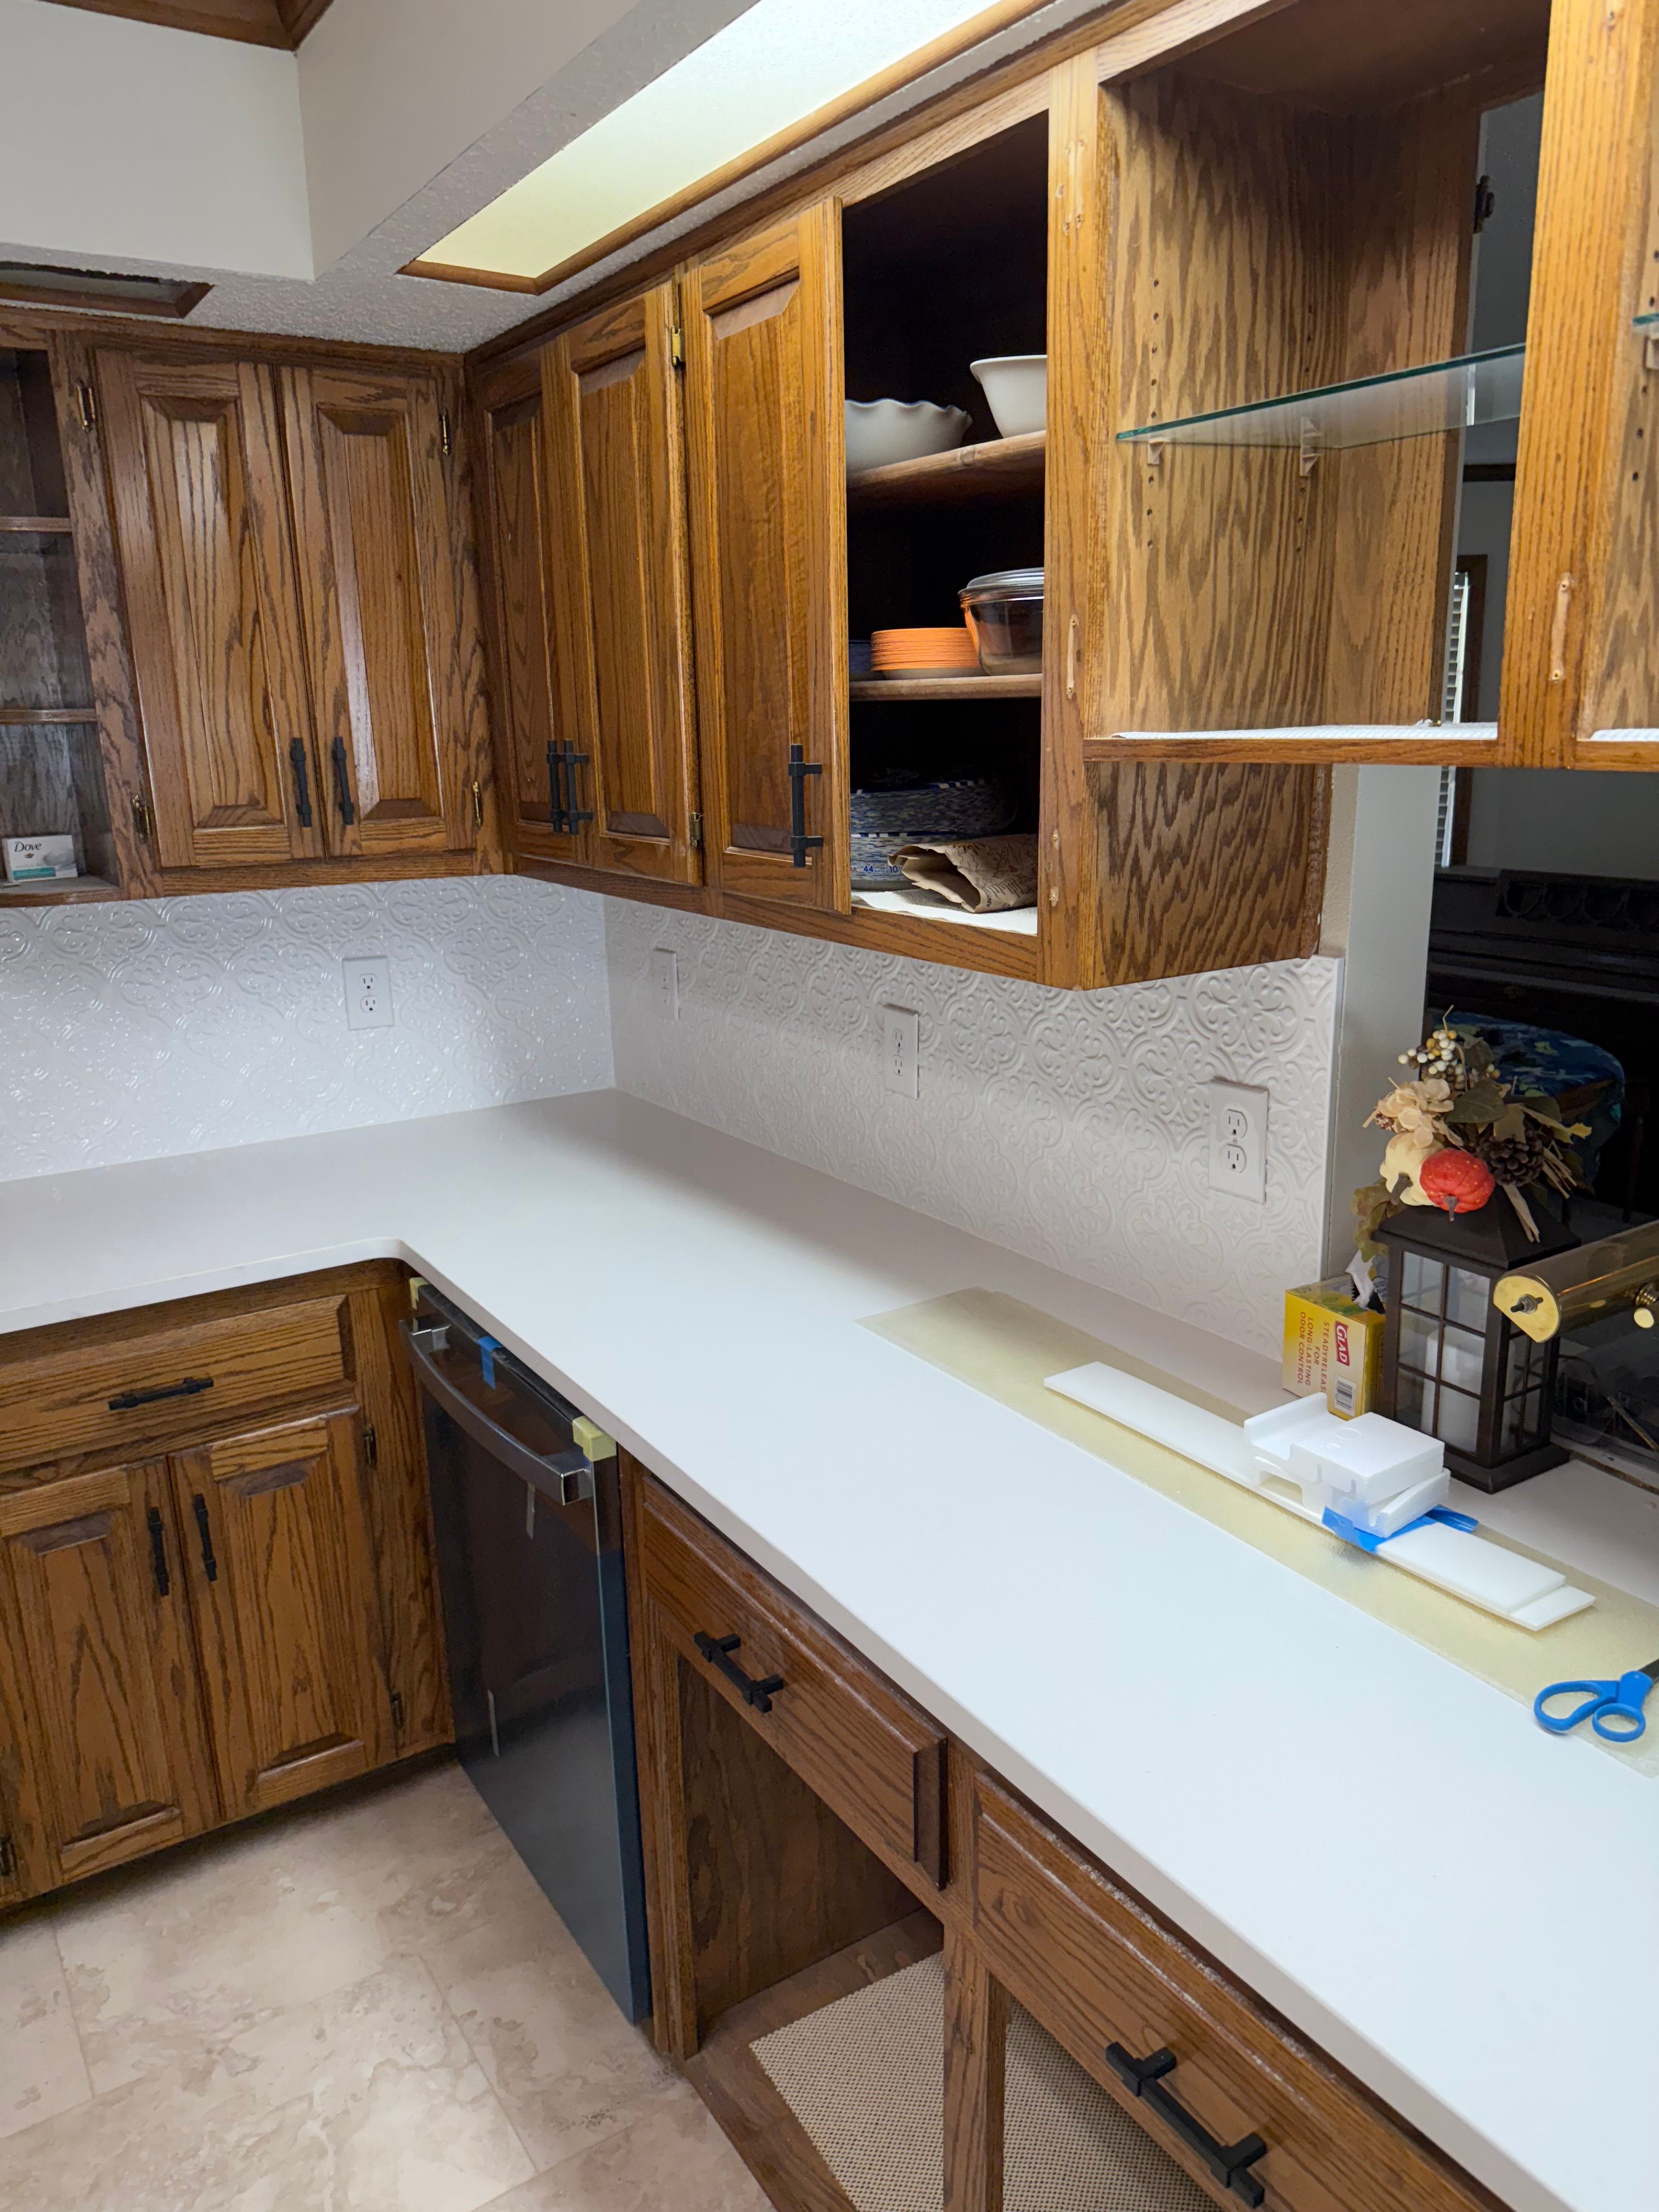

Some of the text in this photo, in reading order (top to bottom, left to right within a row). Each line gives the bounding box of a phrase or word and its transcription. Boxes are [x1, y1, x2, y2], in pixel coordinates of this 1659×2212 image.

[14, 841, 42, 852] Dove
[1305, 1317, 1314, 1386] LONG-LASTING
[1335, 1324, 1349, 1363] GLAD
